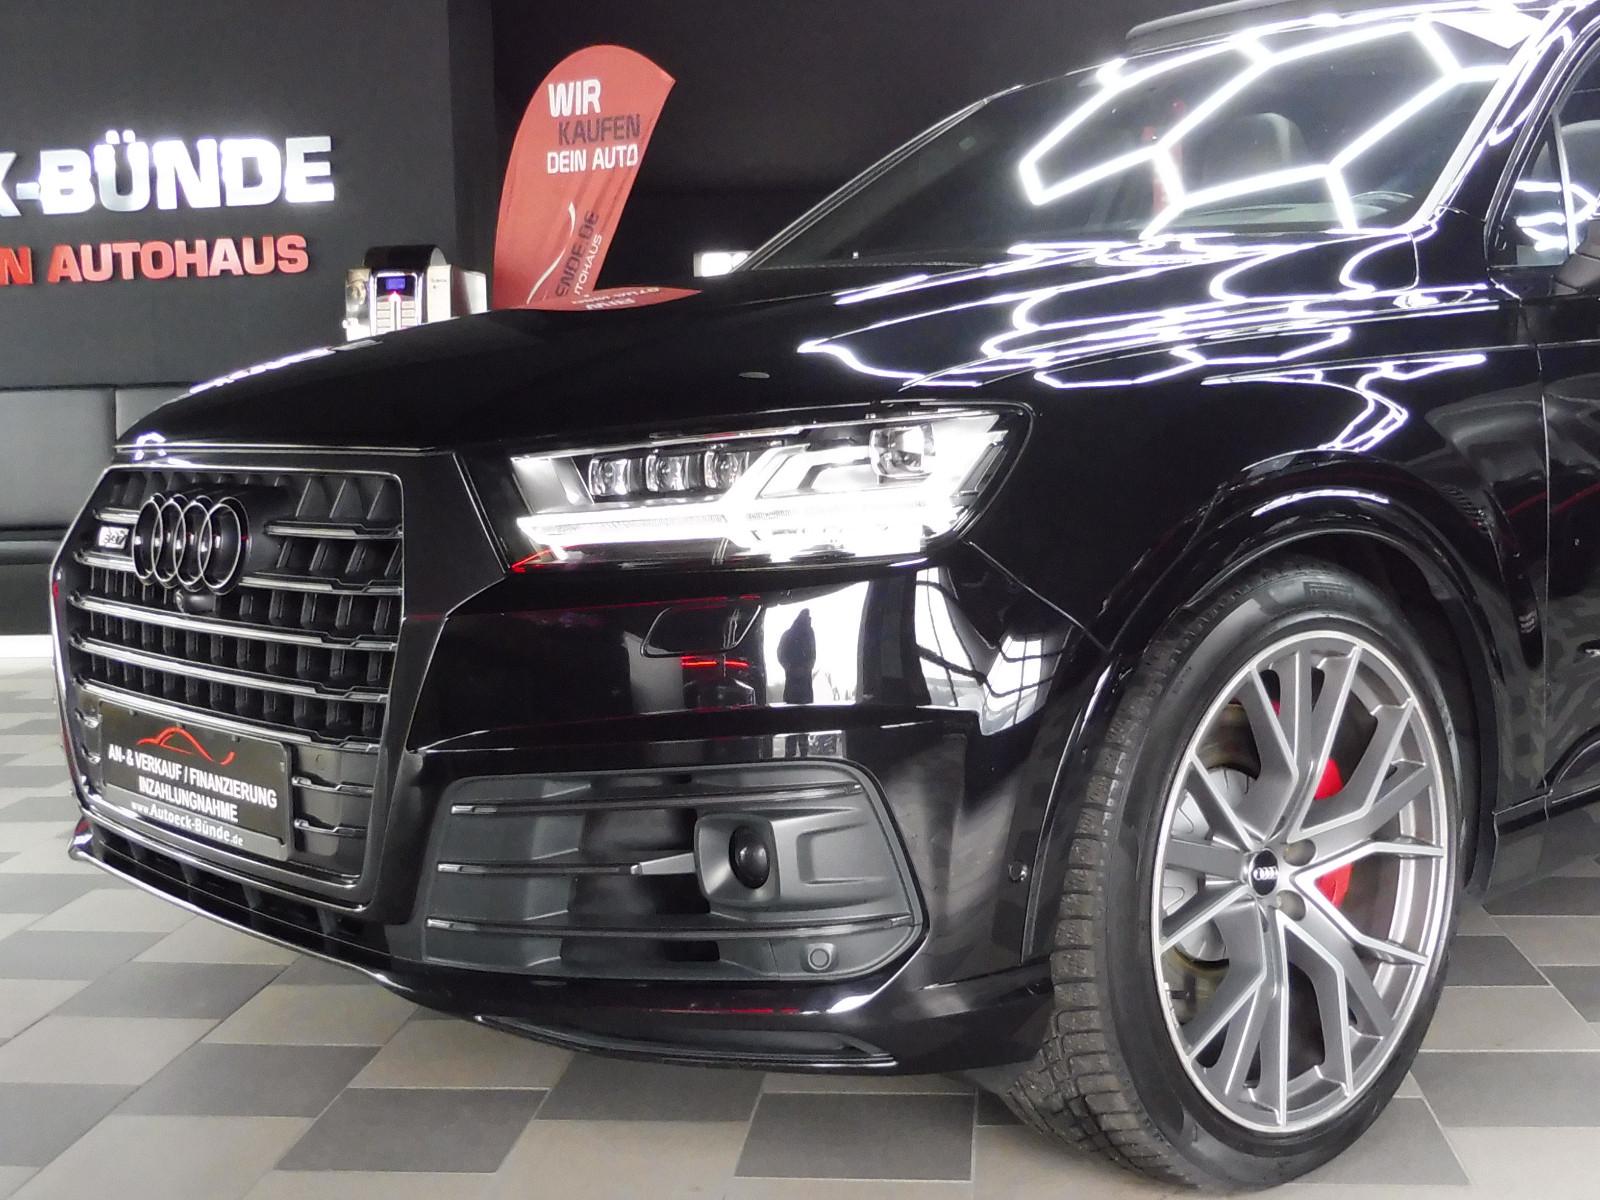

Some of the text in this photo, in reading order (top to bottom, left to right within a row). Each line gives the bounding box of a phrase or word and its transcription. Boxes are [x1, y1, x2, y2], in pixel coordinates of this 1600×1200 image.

[548, 79, 601, 117] WIR
[558, 114, 641, 145] KAUFEN
[547, 143, 639, 174] DEIN AUTO
[48, 235, 309, 283] AUTOHAUS
[108, 743, 125, 763] AN-
[126, 750, 134, 766] &
[135, 751, 183, 781] VERKAUF
[189, 767, 277, 809] FINANZIERUNG
[138, 775, 238, 823] INZAHLUNGNAHME
[131, 801, 244, 847] www.Autoeck-Bünde.de
